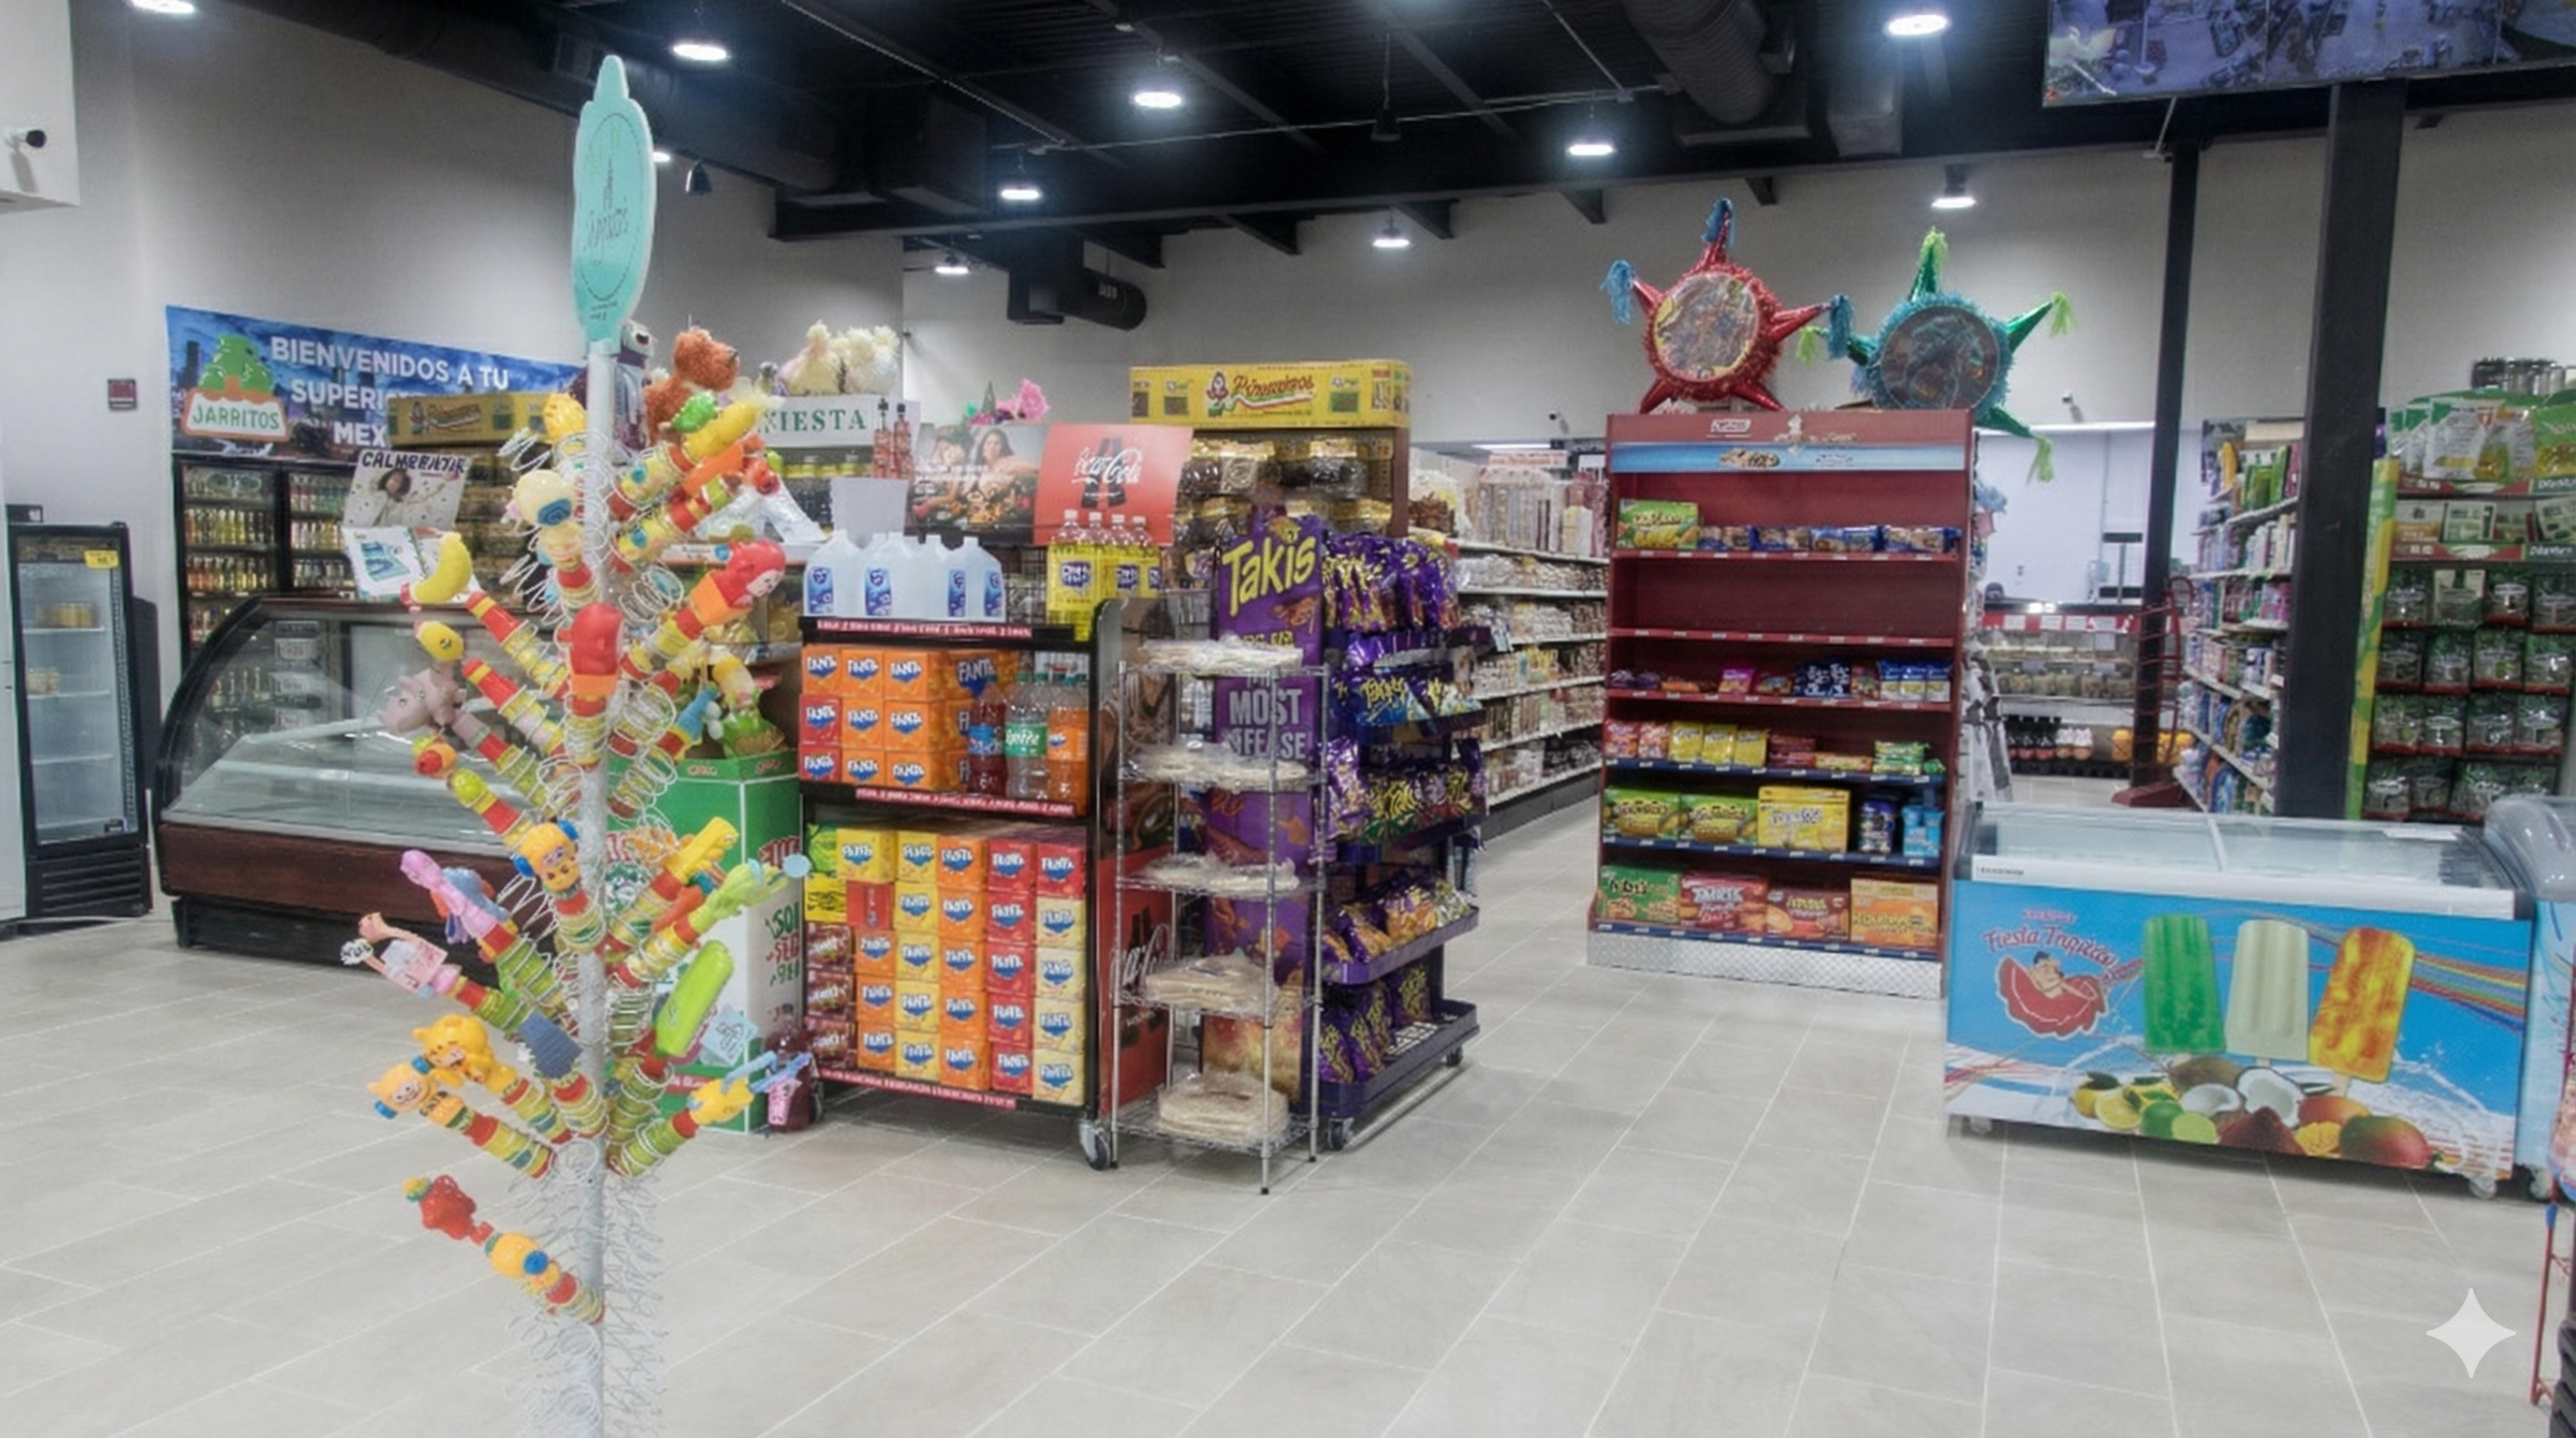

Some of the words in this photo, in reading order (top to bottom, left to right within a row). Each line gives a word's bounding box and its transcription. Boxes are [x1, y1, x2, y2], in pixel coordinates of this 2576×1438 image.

[271, 336, 449, 381] BIENVENIDOS
[458, 367, 474, 386] A
[479, 366, 509, 390] TU
[191, 404, 281, 432] JARRITOS
[1222, 536, 1316, 617] Takis
[1228, 688, 1303, 726] MOST
[1982, 923, 2040, 952] Fiesta
